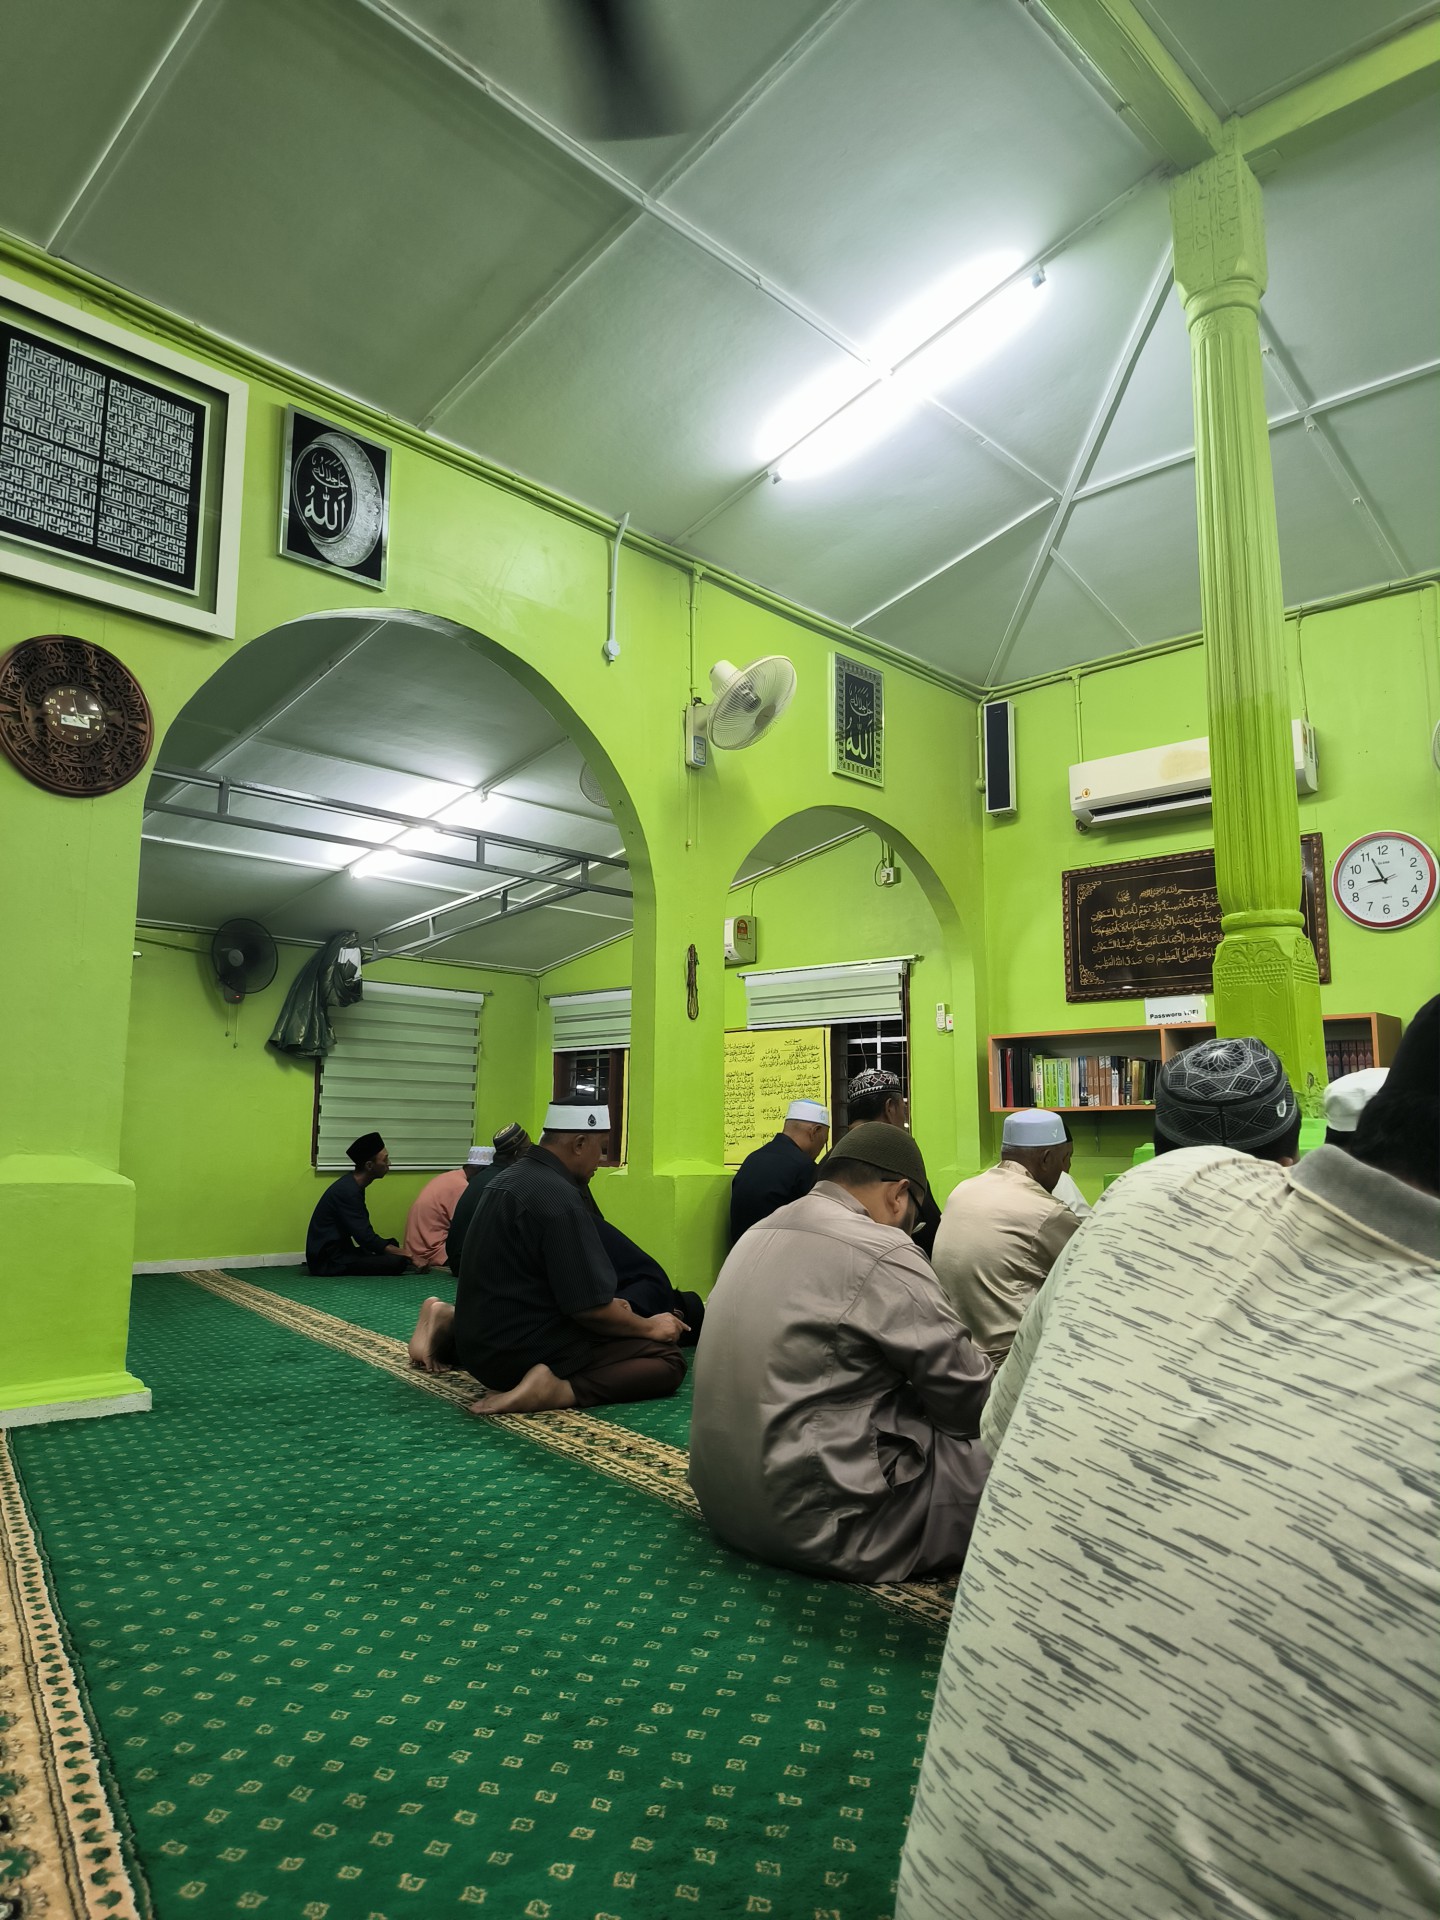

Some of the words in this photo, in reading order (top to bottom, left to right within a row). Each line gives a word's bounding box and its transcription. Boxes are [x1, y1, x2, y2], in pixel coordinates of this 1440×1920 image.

[1377, 845, 1388, 856] 12
[1399, 847, 1405, 857] 1
[1361, 852, 1370, 862] 11
[1409, 857, 1418, 868] 2
[1350, 864, 1362, 875] 10
[1415, 870, 1424, 881] 3
[1347, 879, 1355, 889] 9
[1411, 884, 1418, 894] 4
[1352, 892, 1360, 902] 8
[1402, 897, 1410, 907] 5
[1366, 901, 1374, 911] 7
[1382, 904, 1391, 914] 6
